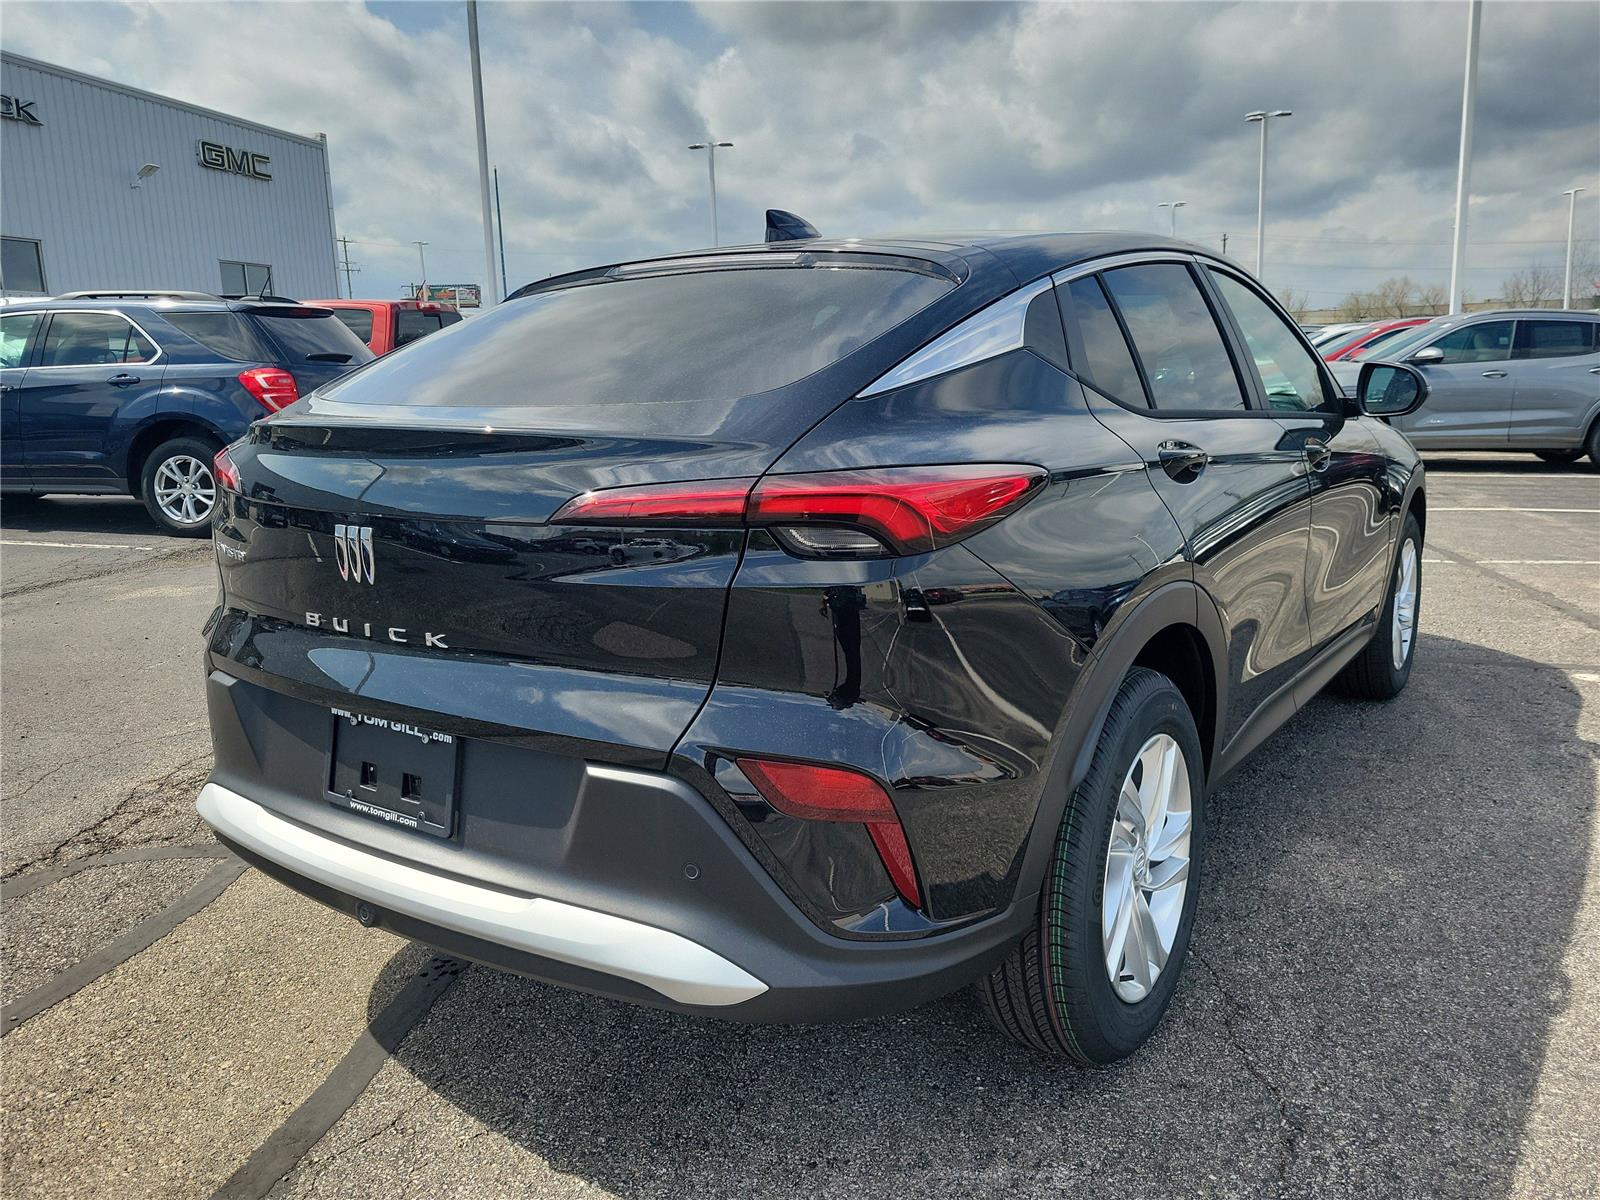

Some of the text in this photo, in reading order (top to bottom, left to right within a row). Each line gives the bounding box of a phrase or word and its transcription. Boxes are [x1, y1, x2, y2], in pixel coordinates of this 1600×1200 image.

[198, 139, 272, 182] GMC
[305, 611, 449, 649] BUICK
[390, 721, 423, 737] GILL
[349, 800, 418, 828] www.tomgill.com
